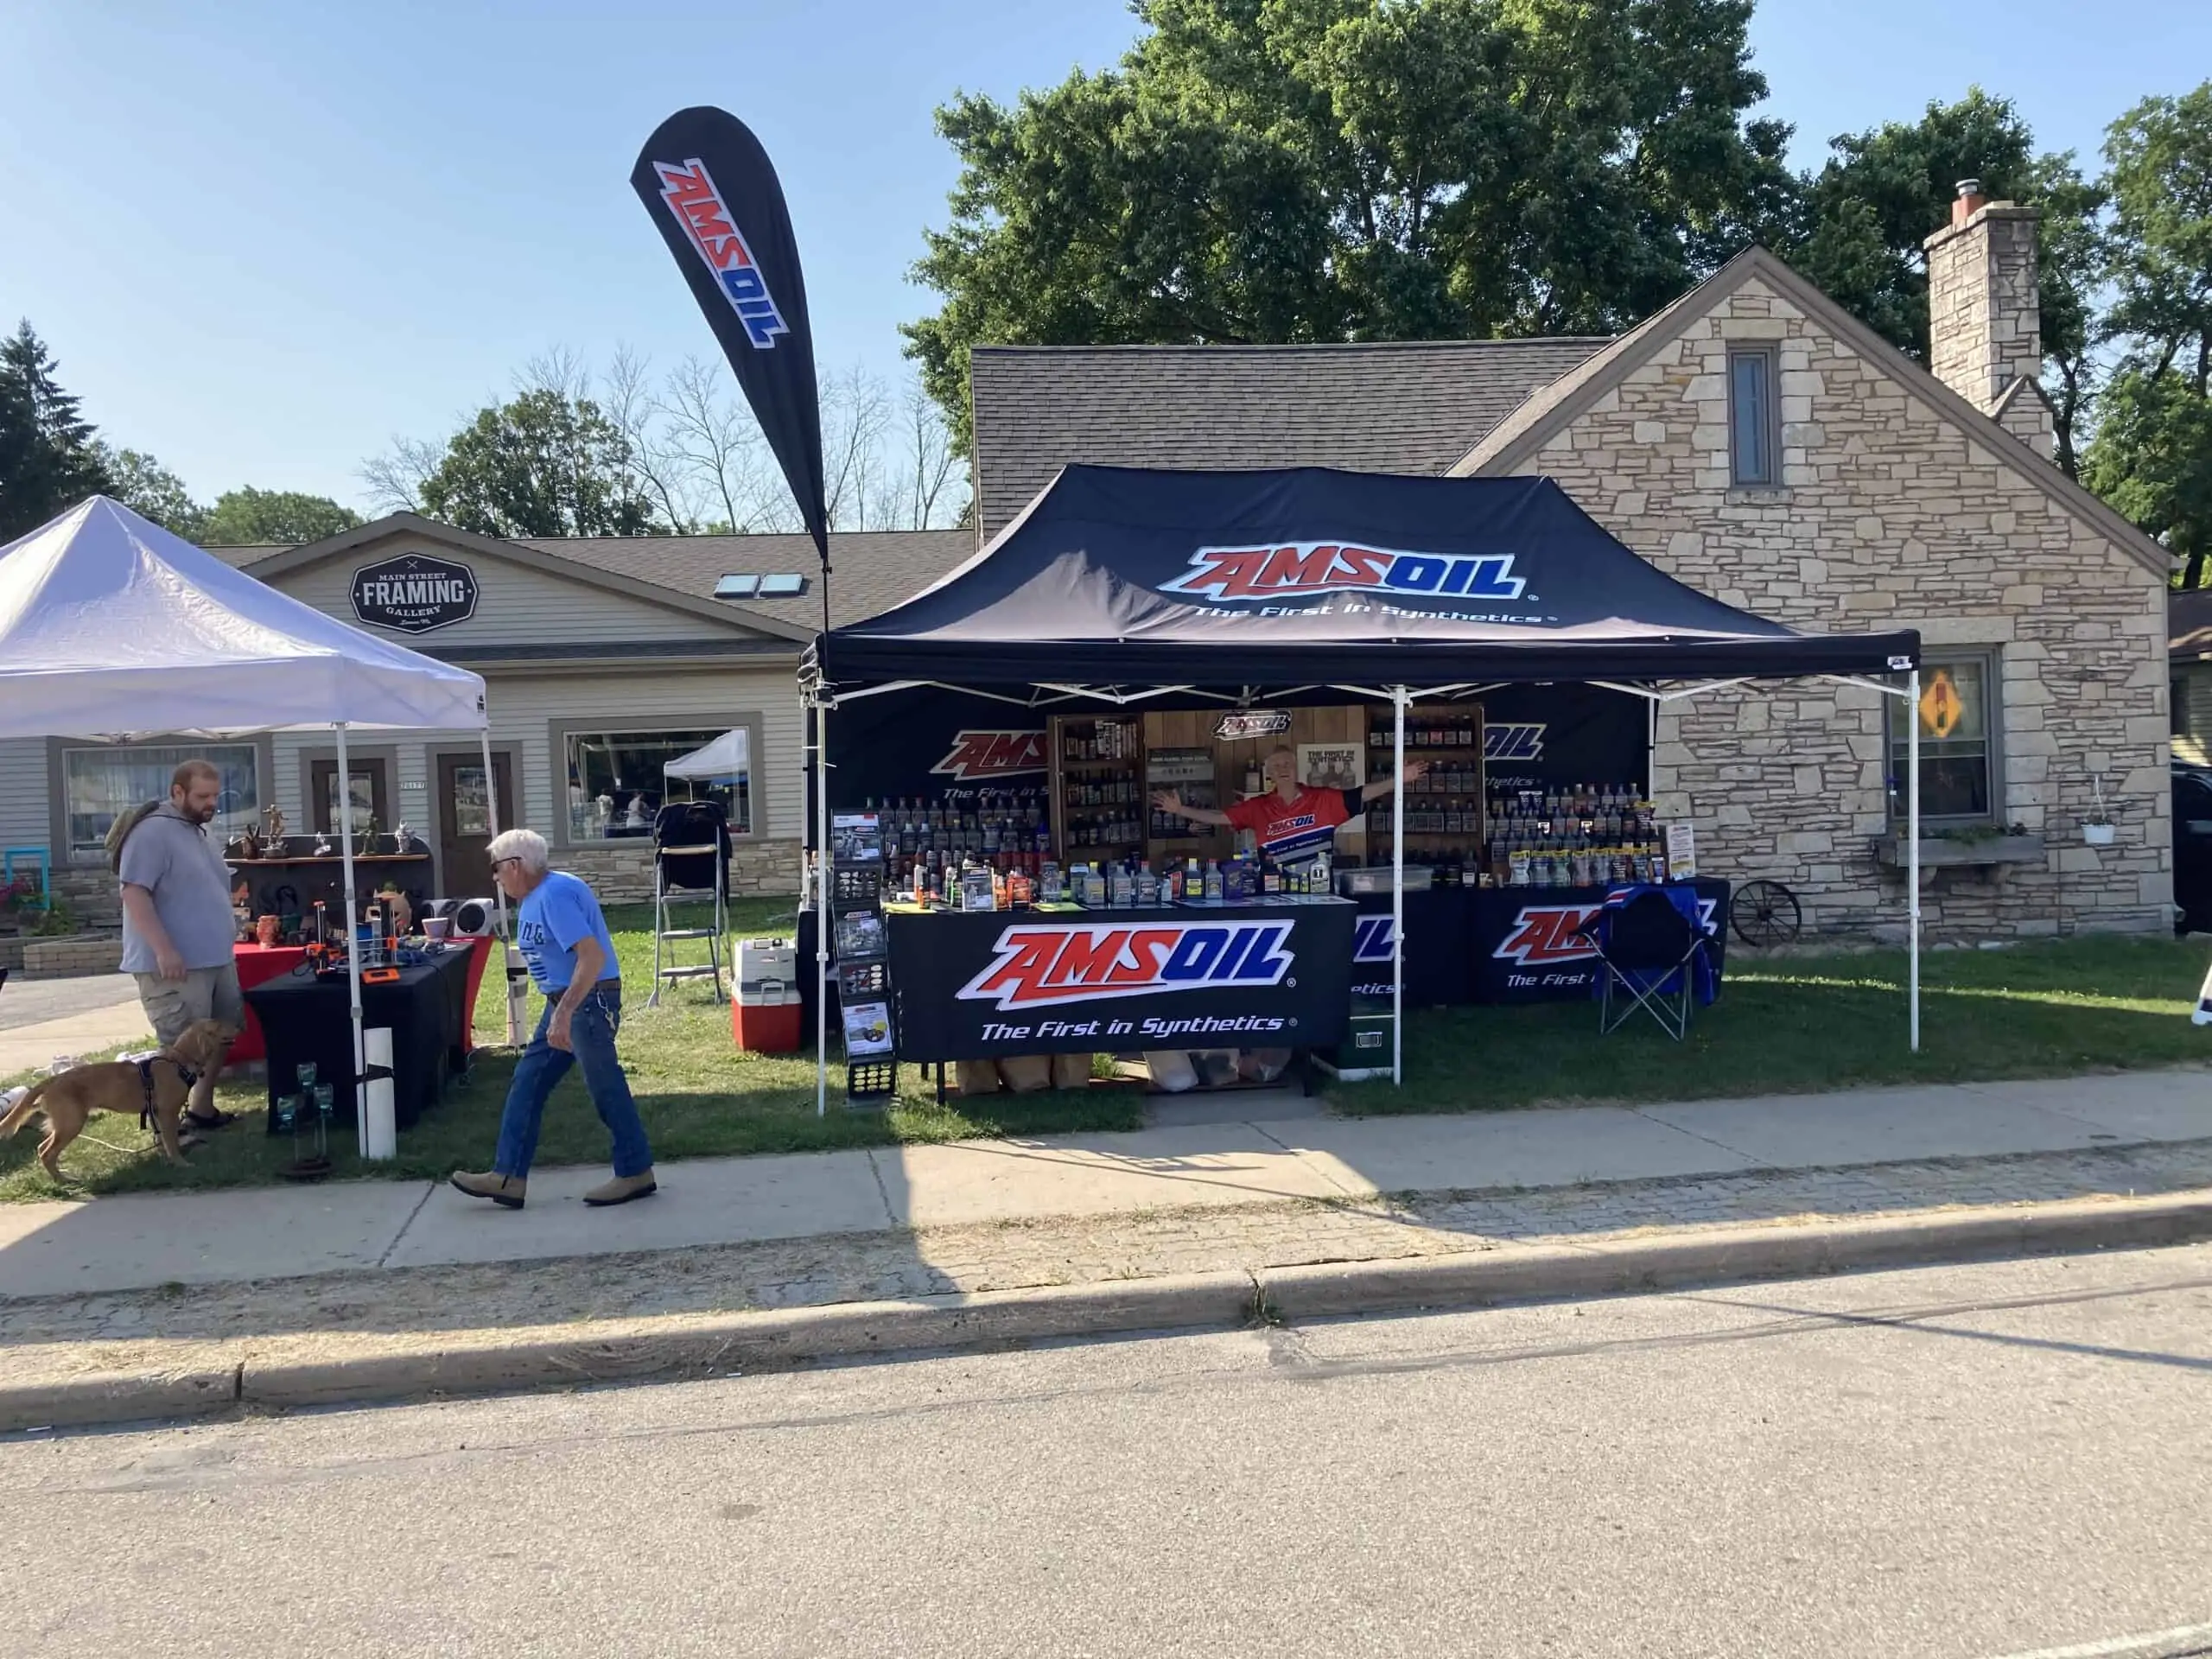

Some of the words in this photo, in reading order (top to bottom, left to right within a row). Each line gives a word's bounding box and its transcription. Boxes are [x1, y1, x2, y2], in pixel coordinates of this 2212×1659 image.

[653, 158, 790, 349] AMSOIL
[408, 572, 448, 581] STREET
[1156, 541, 1526, 601] AMSOIL
[362, 580, 465, 606] FRAMING
[385, 605, 442, 617] GALLERY
[1195, 607, 1251, 618] The
[1260, 606, 1332, 617] First
[1343, 602, 1371, 614] in
[1381, 606, 1542, 623] Synthetics
[1484, 723, 1547, 760] OIL
[929, 729, 1048, 781] AMS
[944, 788, 974, 799] The
[977, 787, 1017, 798] First
[956, 919, 1295, 1011] AMSOIL
[1508, 975, 1538, 987] The
[1541, 973, 1586, 985] First
[981, 1023, 1031, 1040] The
[1036, 1020, 1100, 1038] First
[1108, 1018, 1134, 1035] in
[1139, 1015, 1285, 1038] Synthetics
